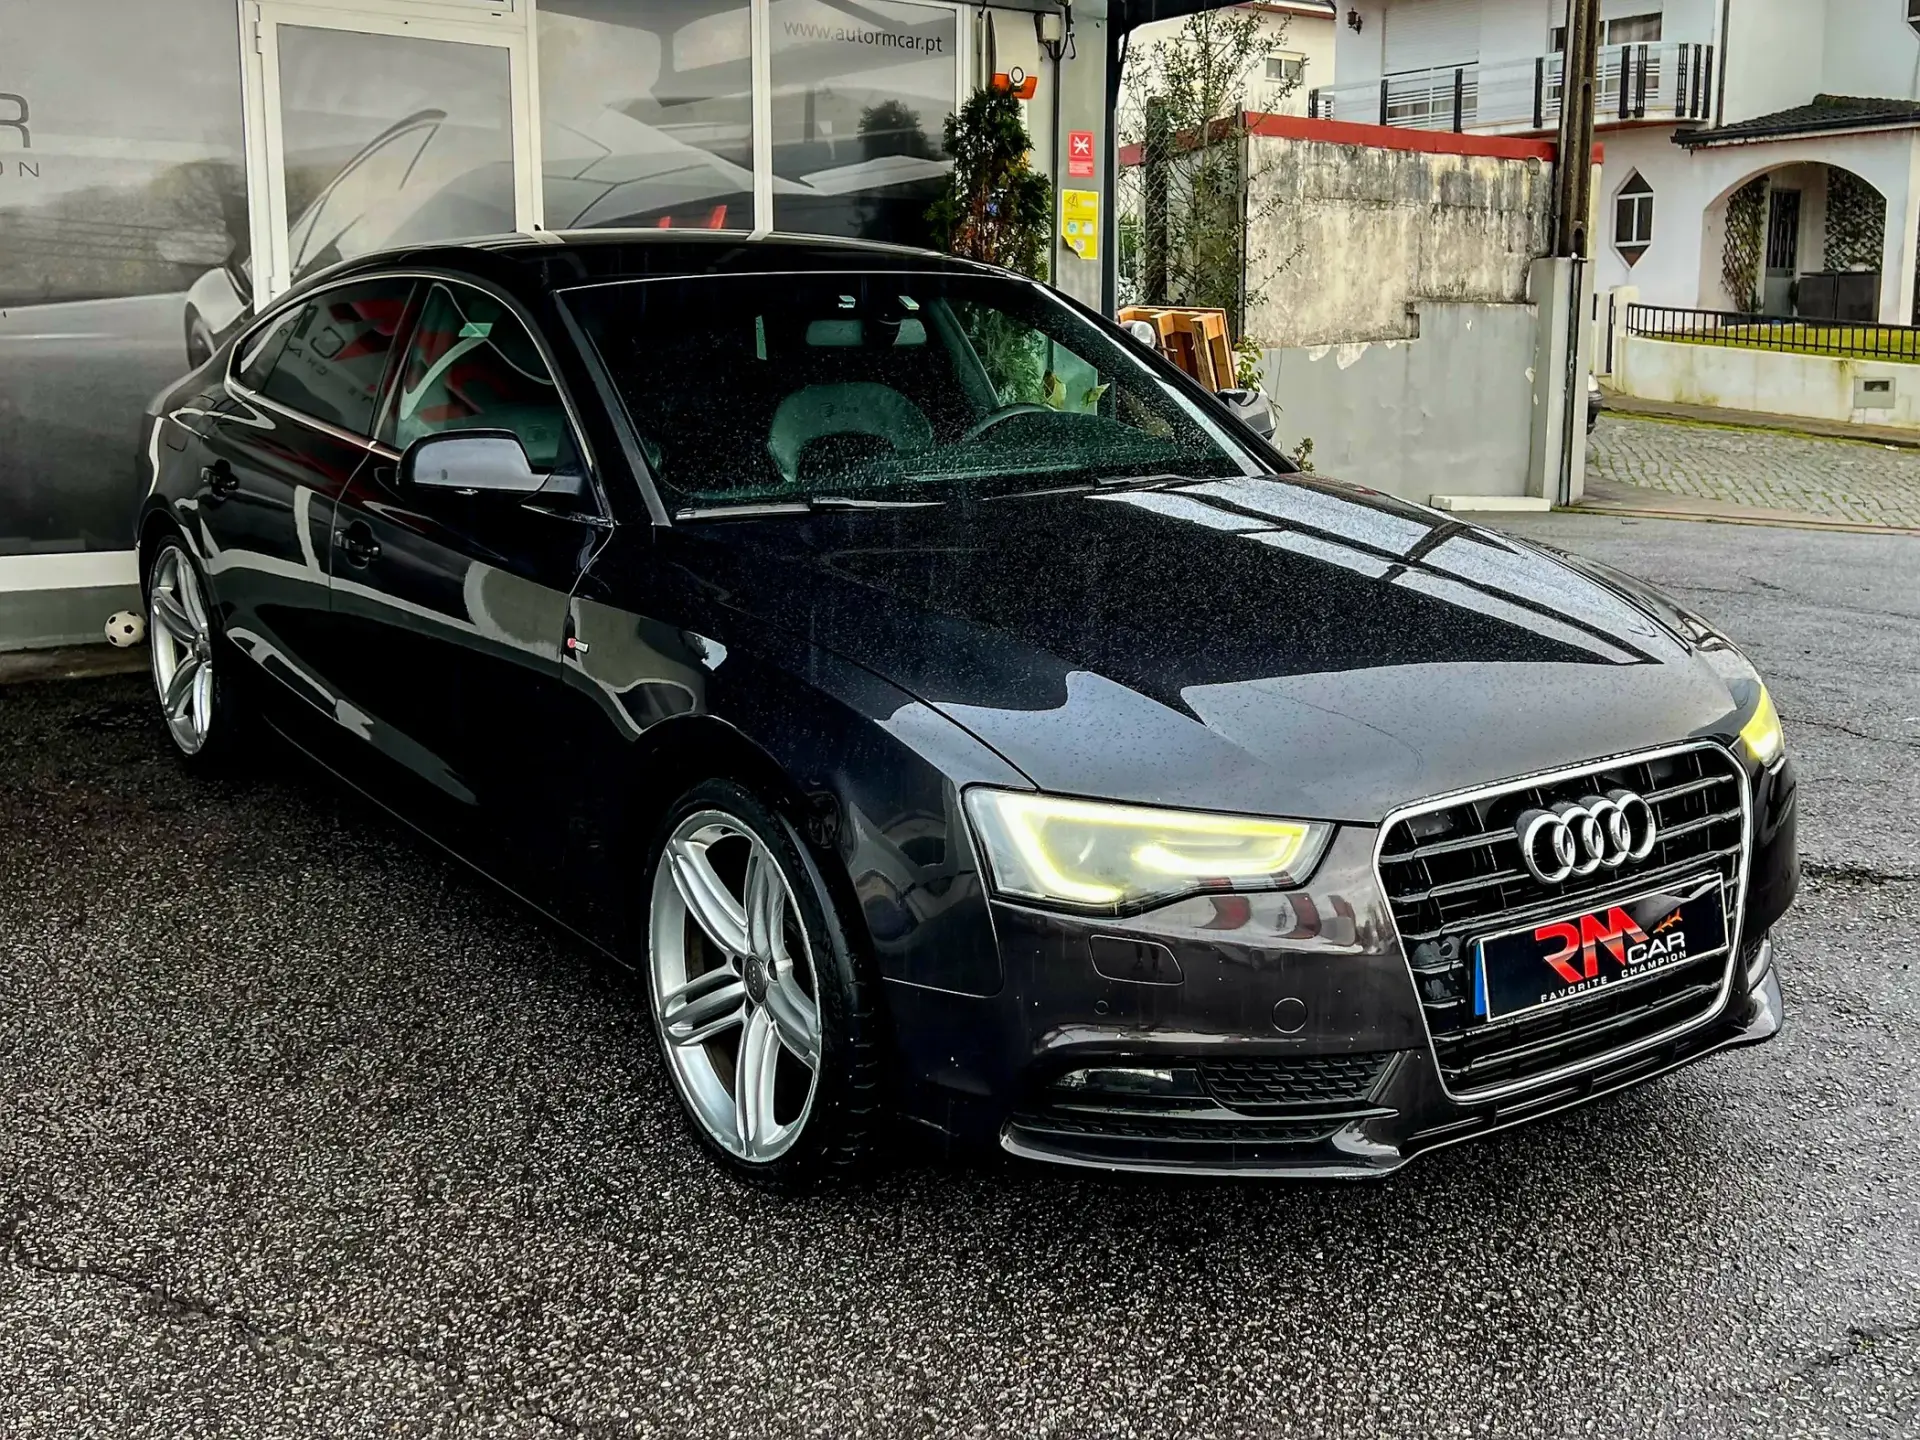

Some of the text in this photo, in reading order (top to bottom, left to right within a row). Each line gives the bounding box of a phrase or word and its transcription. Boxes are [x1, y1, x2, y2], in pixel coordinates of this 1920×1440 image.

[784, 20, 943, 55] www.autormcar.pt
[1534, 906, 1686, 984] RM CAR
[1540, 950, 1687, 1003] FAVORITE CHAMPION
